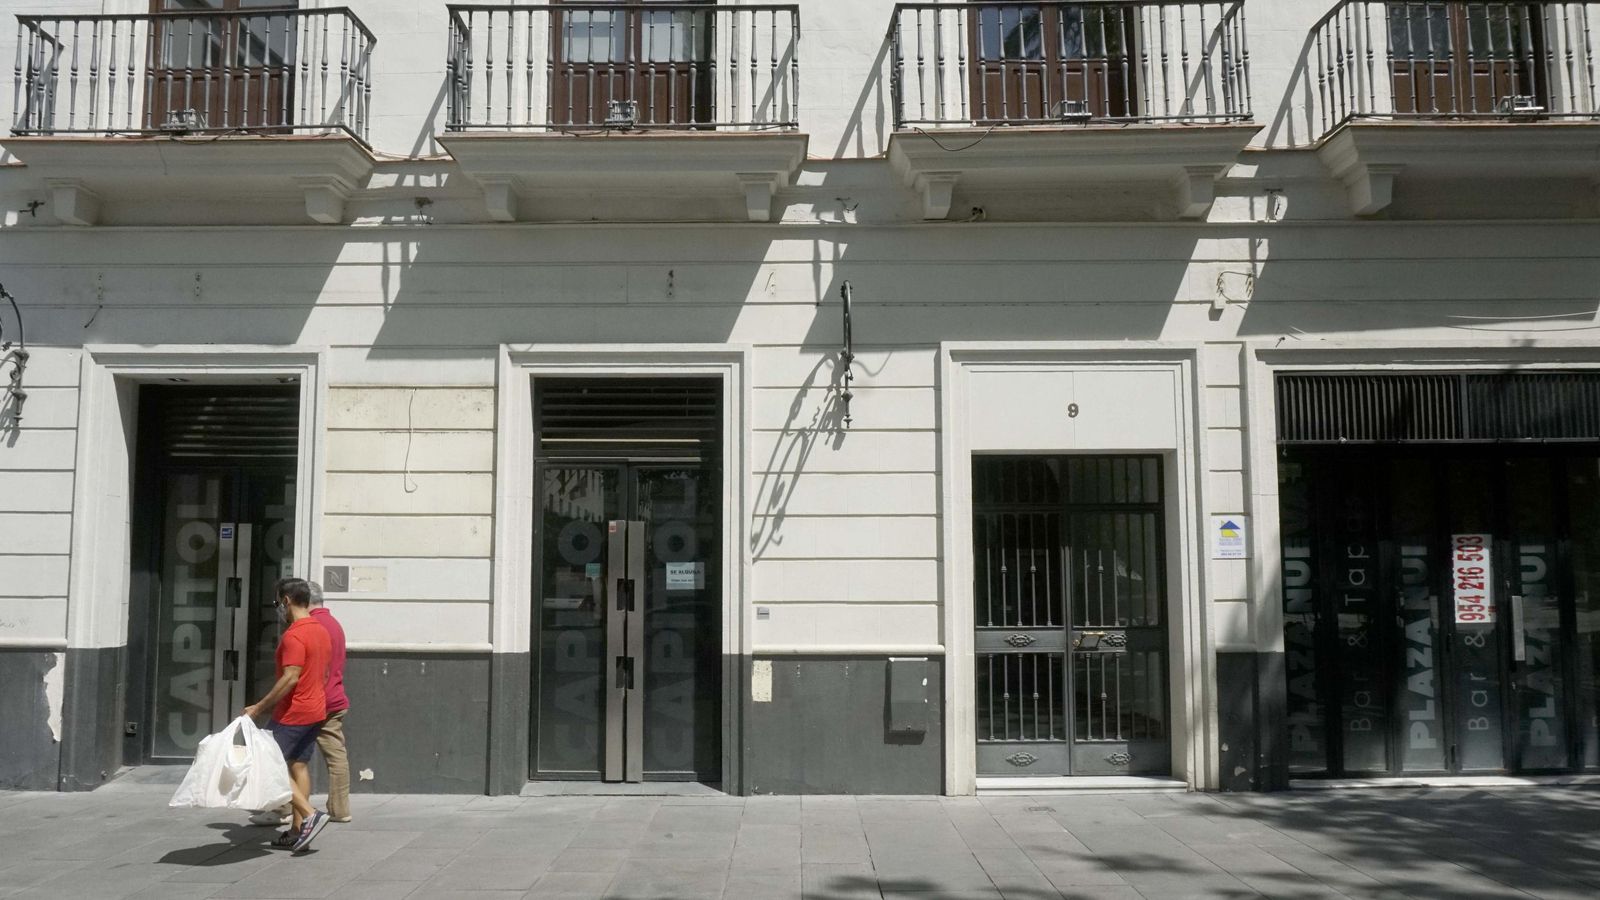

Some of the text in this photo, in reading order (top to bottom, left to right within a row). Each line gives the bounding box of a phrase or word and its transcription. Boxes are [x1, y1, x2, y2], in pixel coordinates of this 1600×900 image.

[1067, 402, 1079, 418] 9
[167, 479, 220, 750] CAPITOL
[1456, 536, 1485, 620] 954 216 503
[1347, 631, 1368, 648] &
[1464, 631, 1490, 731] Bar &
[1350, 674, 1372, 731] Bar
[1405, 617, 1437, 749] PLAZA
